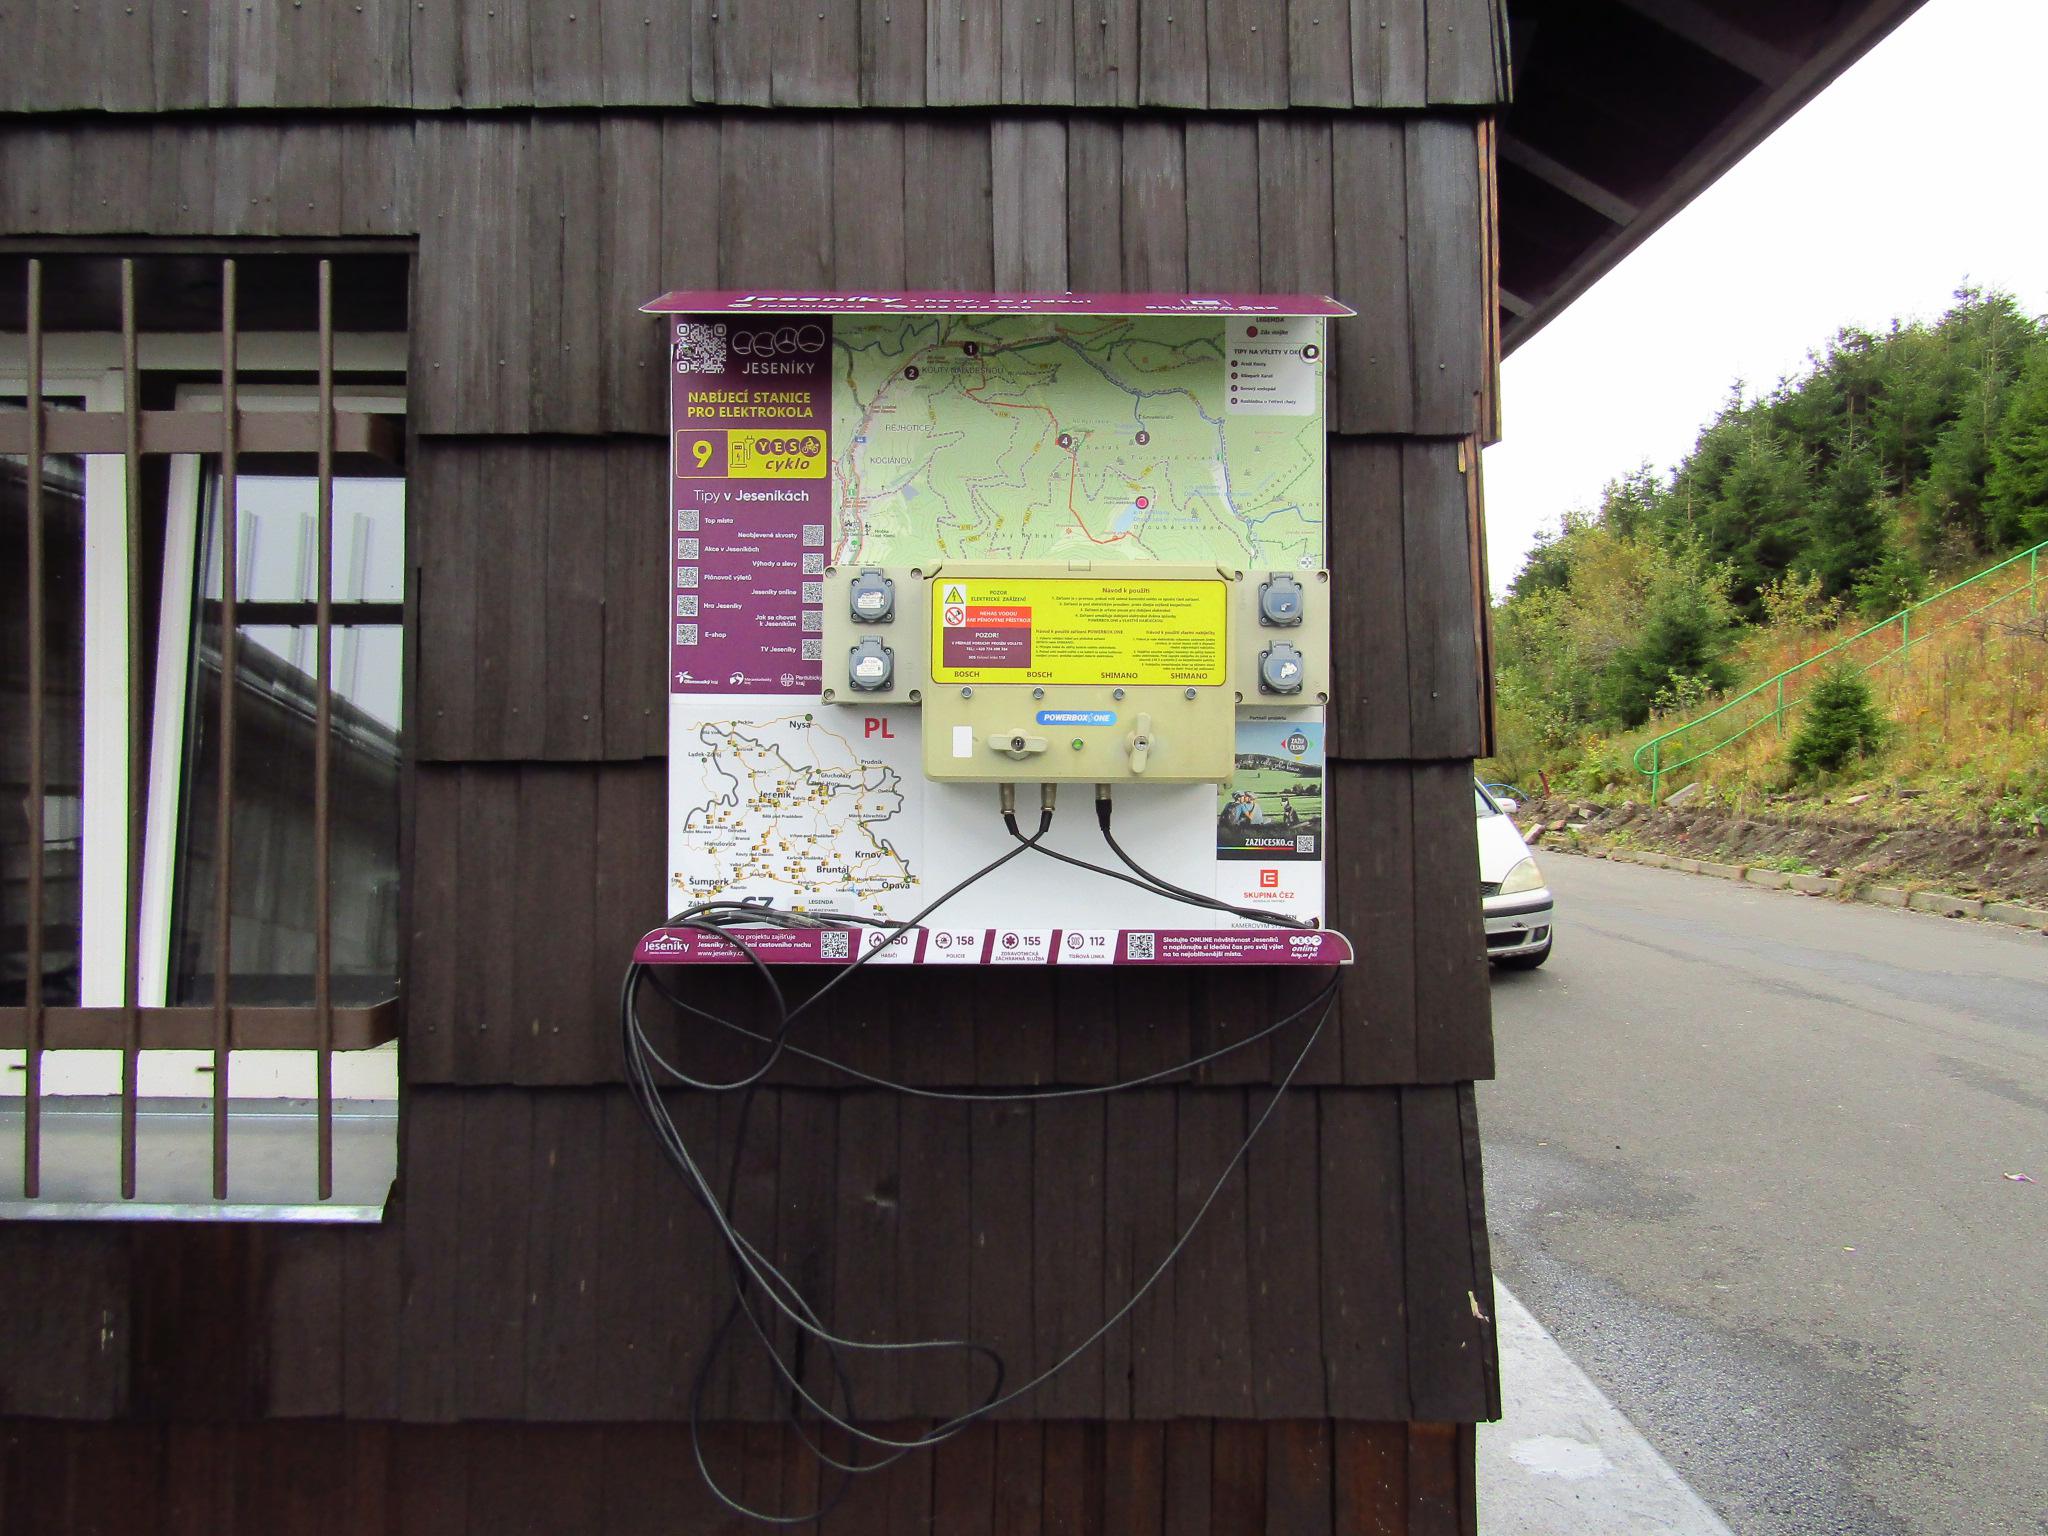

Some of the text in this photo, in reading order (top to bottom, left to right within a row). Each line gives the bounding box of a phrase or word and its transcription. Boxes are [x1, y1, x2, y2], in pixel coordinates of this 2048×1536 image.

[742, 360, 815, 374] JESENÍKY
[688, 389, 810, 403] NABÍJECÍ STANICE
[688, 407, 813, 418] PRO ELEKTROKOLA
[759, 441, 798, 452] YES
[692, 440, 712, 468] 9
[766, 458, 810, 472] cyklo
[694, 490, 721, 504] Tipy
[724, 493, 731, 502] v
[1044, 714, 1109, 722] POWERBOX ONE
[789, 720, 811, 731] Nysa
[865, 718, 894, 738] PL
[855, 851, 881, 859] Krnov
[817, 866, 849, 875] Bruntál
[689, 877, 729, 887] Šumperk
[882, 882, 910, 890] Opava
[1279, 891, 1294, 899] ČEZ
[956, 936, 974, 946] 158
[1023, 936, 1040, 946] 155
[1090, 936, 1105, 946] 112
[1163, 936, 1188, 944] Sledujte
[644, 942, 690, 952] Jeseníky
